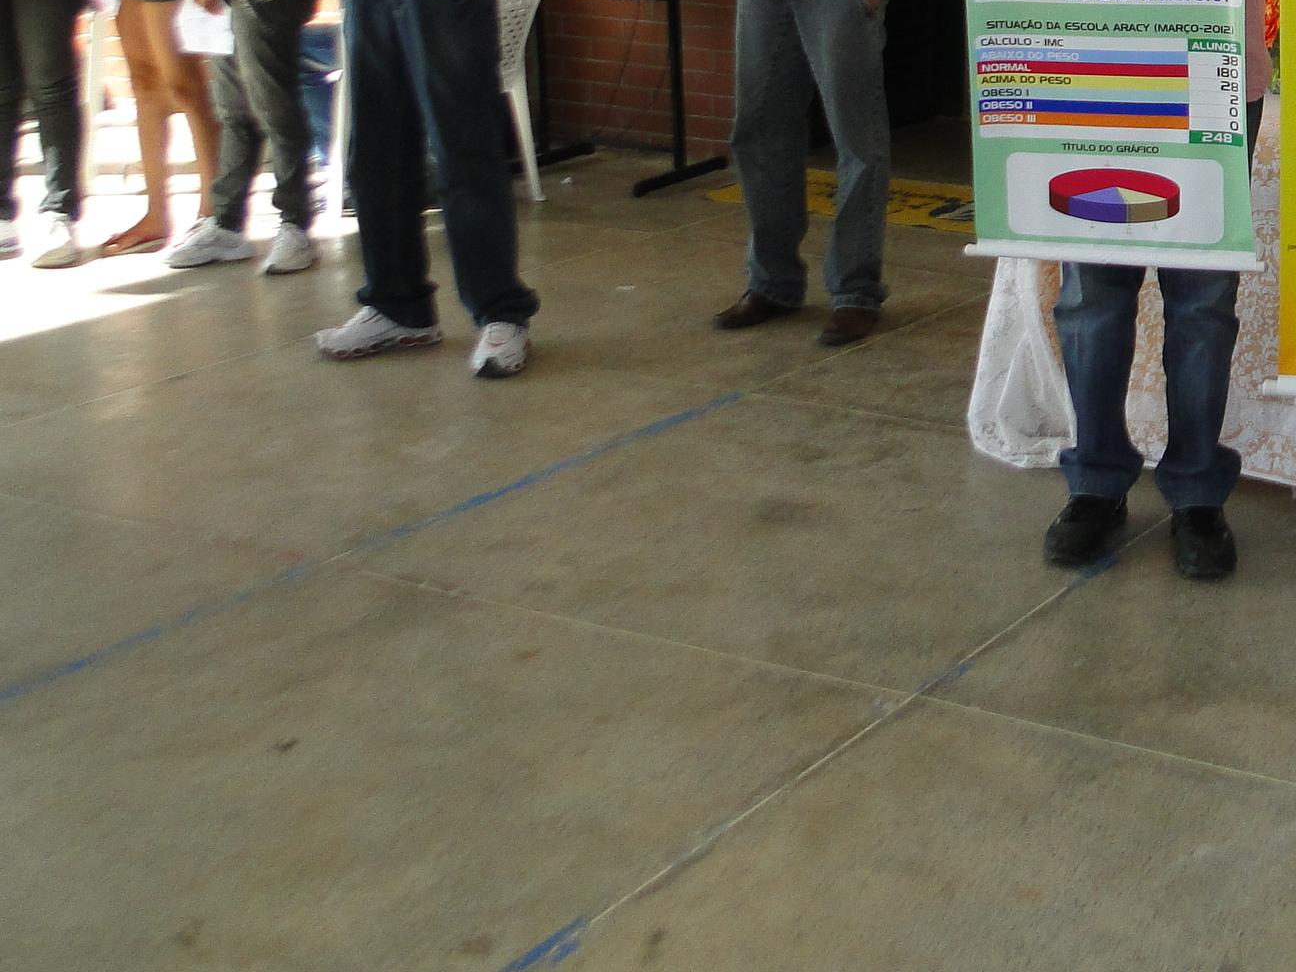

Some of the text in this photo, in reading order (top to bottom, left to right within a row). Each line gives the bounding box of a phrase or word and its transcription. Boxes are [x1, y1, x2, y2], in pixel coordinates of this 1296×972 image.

[986, 19, 1043, 31] SITUAÇÃO
[1046, 21, 1061, 30] DA
[1064, 22, 1109, 32] ESCOLA
[1113, 23, 1150, 32] ARACY
[980, 36, 1064, 47] CÁLCULO IMC
[1191, 41, 1237, 52] ALUNOS
[980, 51, 1080, 60] ABAIXO DO PESO
[1221, 55, 1239, 67] 38
[981, 62, 1031, 72] NORMAL
[1216, 67, 1239, 79] 180
[981, 75, 1072, 85] ACIMA DO PESO
[1220, 81, 1239, 92] 28
[981, 88, 1030, 97] OBESO I
[982, 101, 1033, 110] OBESO II
[1229, 95, 1239, 105] 2
[982, 113, 1036, 123] OBESO III
[1229, 107, 1238, 118] 0
[1229, 121, 1239, 131] 0
[1201, 132, 1233, 143] 248
[1061, 142, 1159, 154] TÍTULO DO GRÁFICO
